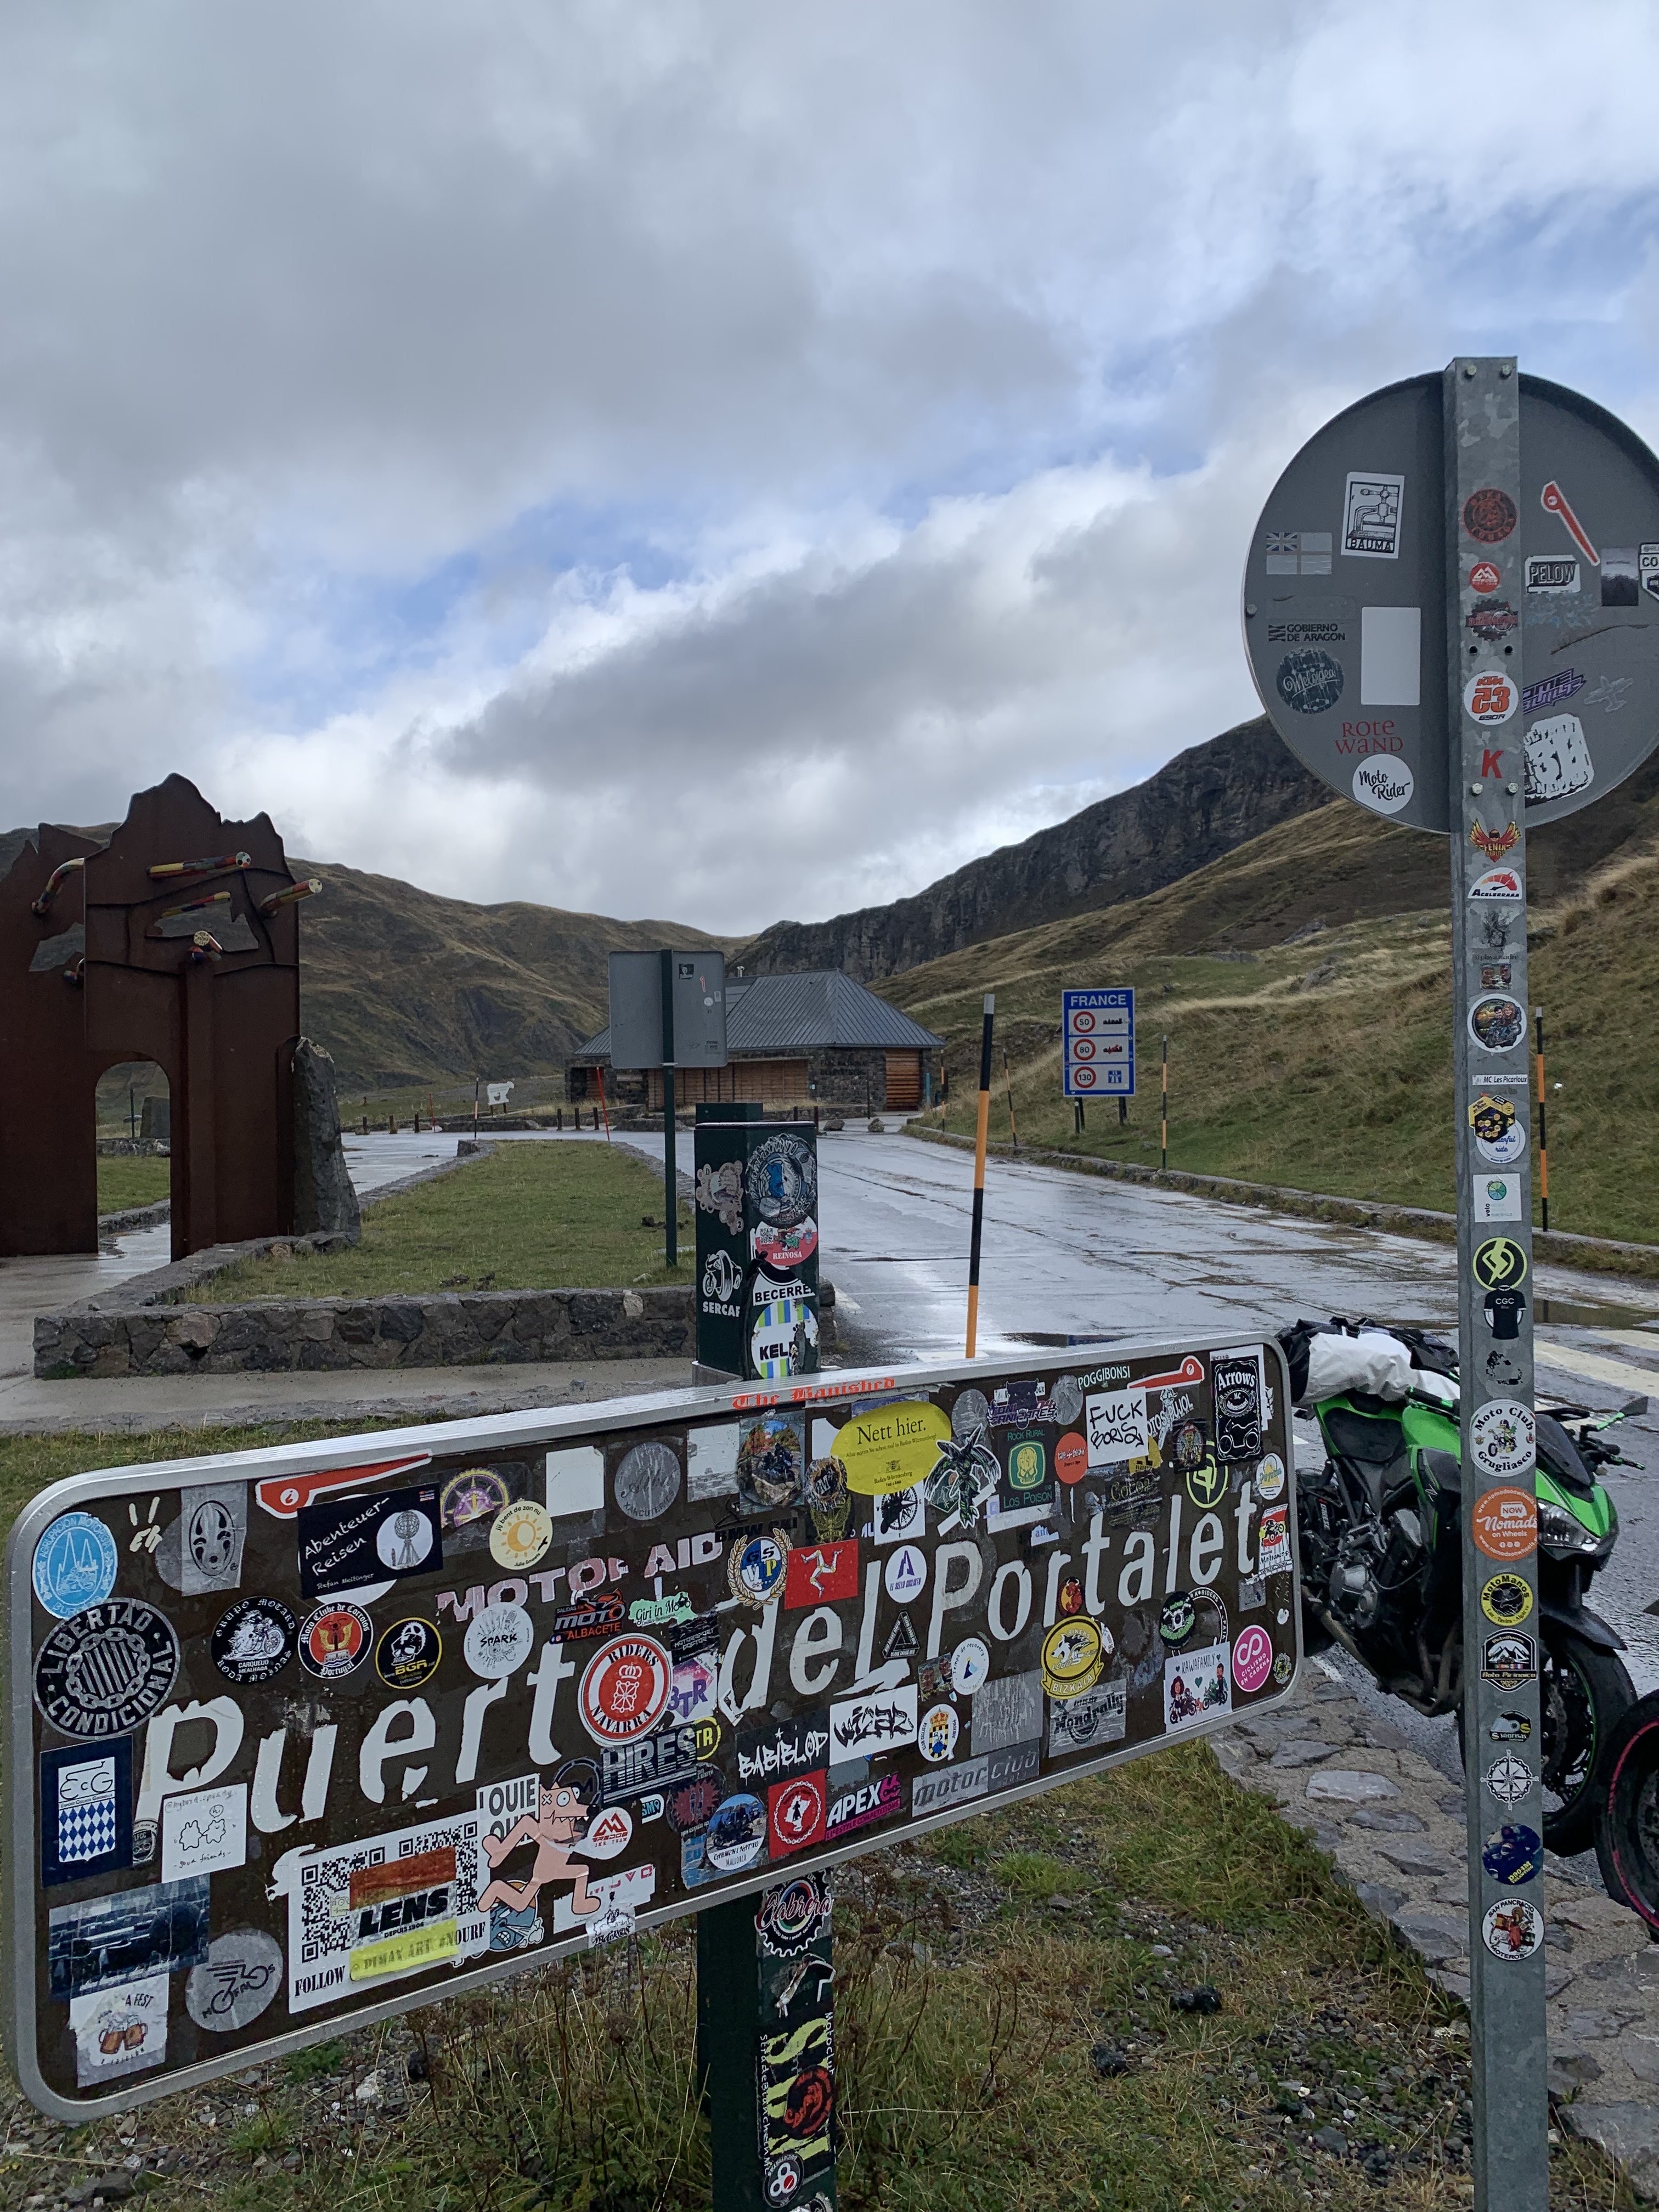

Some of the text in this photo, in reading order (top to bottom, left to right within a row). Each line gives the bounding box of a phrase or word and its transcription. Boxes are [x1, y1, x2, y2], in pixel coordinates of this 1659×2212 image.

[1350, 539, 1392, 551] BAUMA
[1287, 623, 1338, 633] GOBIERNO
[1287, 633, 1345, 642] DE ARAGON
[1476, 676, 1504, 686] KTM
[1481, 748, 1505, 779] K
[1359, 770, 1389, 787] Moto
[1372, 781, 1410, 801] Rider
[1070, 995, 1126, 1006] FRANCE
[772, 1251, 803, 1260] REINOSA
[755, 1284, 814, 1303] BECERRE
[1077, 1365, 1130, 1390] POGGIBONSI
[1218, 1371, 1256, 1391] Arrows
[1090, 1400, 1143, 1430] FUCK
[1167, 1393, 1194, 1421] PUJOL
[1475, 1407, 1533, 1431] Moto Club
[857, 1418, 927, 1444] Nett hier.
[1007, 1428, 1045, 1441] ROCK RURAL
[1478, 1451, 1532, 1472] Grugliasco
[1003, 1491, 1052, 1509] LOS POISON
[499, 1510, 514, 1525] bent
[532, 1506, 541, 1515] nu
[1476, 1514, 1537, 1532] Nomads
[305, 1497, 390, 1560] Abenteuer-
[312, 1537, 367, 1576] Reisen
[644, 1532, 723, 1578] AID
[746, 1558, 777, 1582] VIP
[316, 1580, 339, 1589] Stefan
[889, 1583, 895, 1591] EL
[895, 1579, 905, 1590] SELLO
[1482, 1575, 1530, 1601] MotoManos
[1201, 1590, 1218, 1602] RIDERS
[216, 1601, 249, 1637] GRUPO
[556, 1605, 577, 1614] SALIDAS
[636, 1605, 663, 1626] Giri in
[301, 1621, 315, 1645] Moto
[313, 1605, 336, 1622] Clube
[336, 1603, 345, 1611] de
[567, 1622, 622, 1641] ALBACETE
[1068, 1628, 1091, 1640] BIKERS
[41, 1603, 152, 1675] LIBERTAD
[480, 1633, 518, 1648] SPARK
[136, 1639, 576, 1834] Puert
[927, 1480, 1258, 1661] Portalet
[607, 1644, 659, 1667] RIDERS
[953, 1652, 961, 1675] Temps
[967, 1642, 985, 1656] recovery
[1182, 1653, 1216, 1674] KAWAFAMILY
[1242, 1652, 1266, 1677] CICLISMO
[320, 1660, 356, 1676] Portugal
[1241, 1658, 1270, 1686] EN CADENA
[47, 1639, 172, 1735] CONDICIONAL
[1052, 1673, 1093, 1692] BIZKAIA
[592, 1705, 652, 1733] NAVARRA
[913, 1765, 988, 1807] motor
[826, 1780, 881, 1828] APEX
[826, 1819, 857, 1839] LIFESTYLE
[726, 1854, 747, 1867] MALLORCA
[358, 1887, 449, 1939] LENS
[755, 1891, 832, 1932] Cabrera
[1488, 1899, 1535, 1918] SAN PANCRACIO
[383, 1921, 425, 1939] DEPUIS 1906
[1491, 1945, 1525, 1960] MOTEROS
[294, 1965, 346, 1997] FOLLOW
[133, 1993, 154, 2007] FEST
